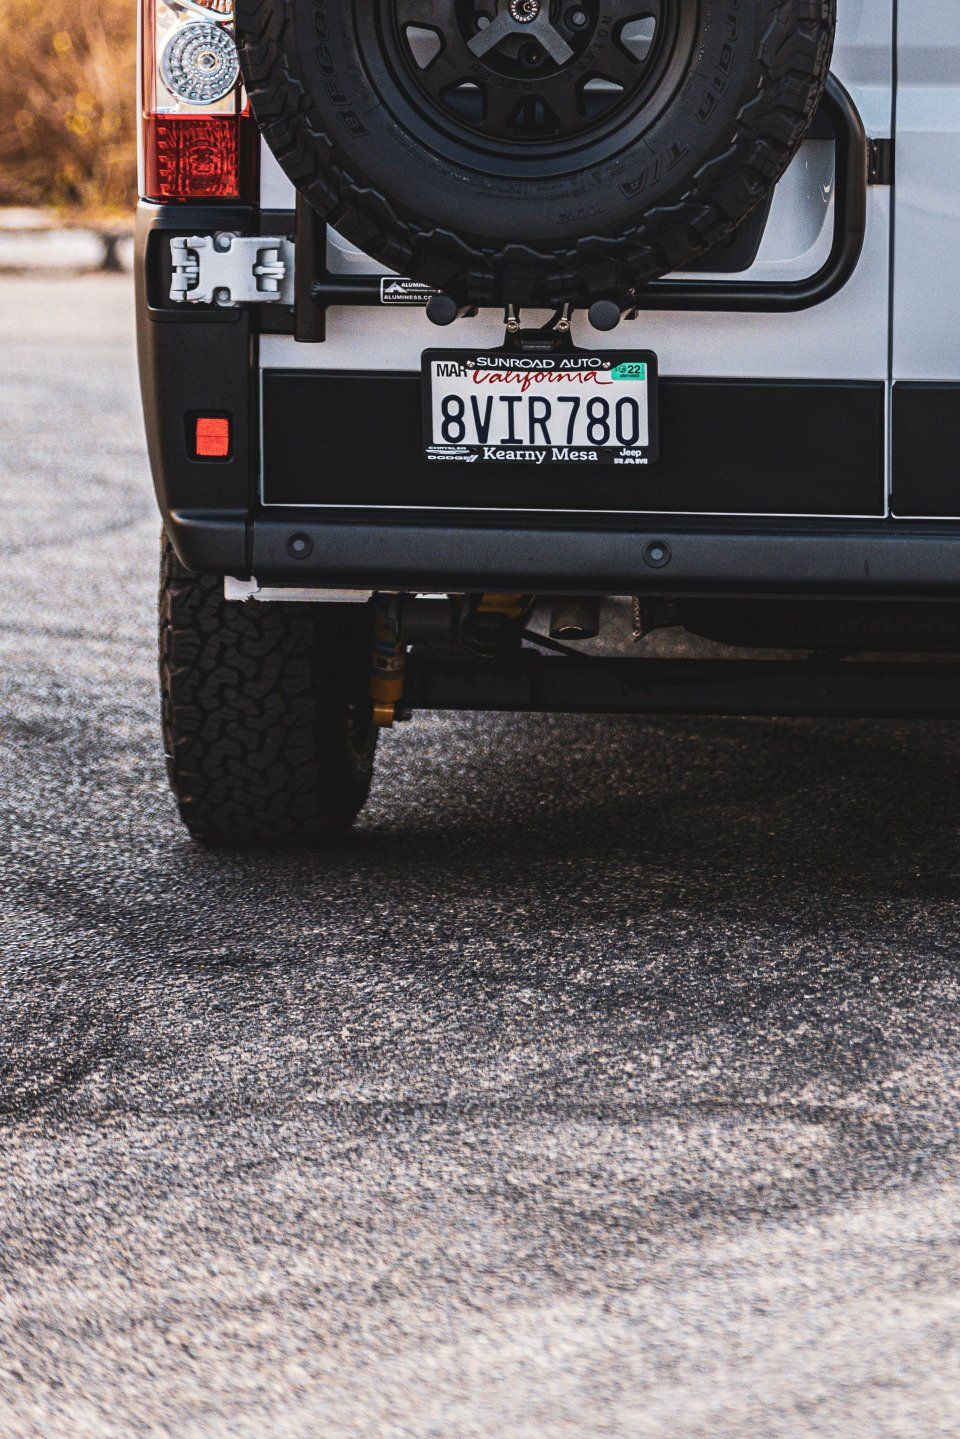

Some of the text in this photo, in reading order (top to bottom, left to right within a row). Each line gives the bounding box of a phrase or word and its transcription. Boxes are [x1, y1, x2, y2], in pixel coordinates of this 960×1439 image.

[617, 140, 691, 199] T/A
[436, 363, 467, 378] MAR
[476, 357, 602, 369] SUNROAD AUTO
[627, 364, 641, 374] 22
[473, 370, 613, 392] California
[440, 394, 640, 446] 8VIR780
[483, 447, 598, 465] Kearny Mesa
[619, 447, 642, 458] Jeep
